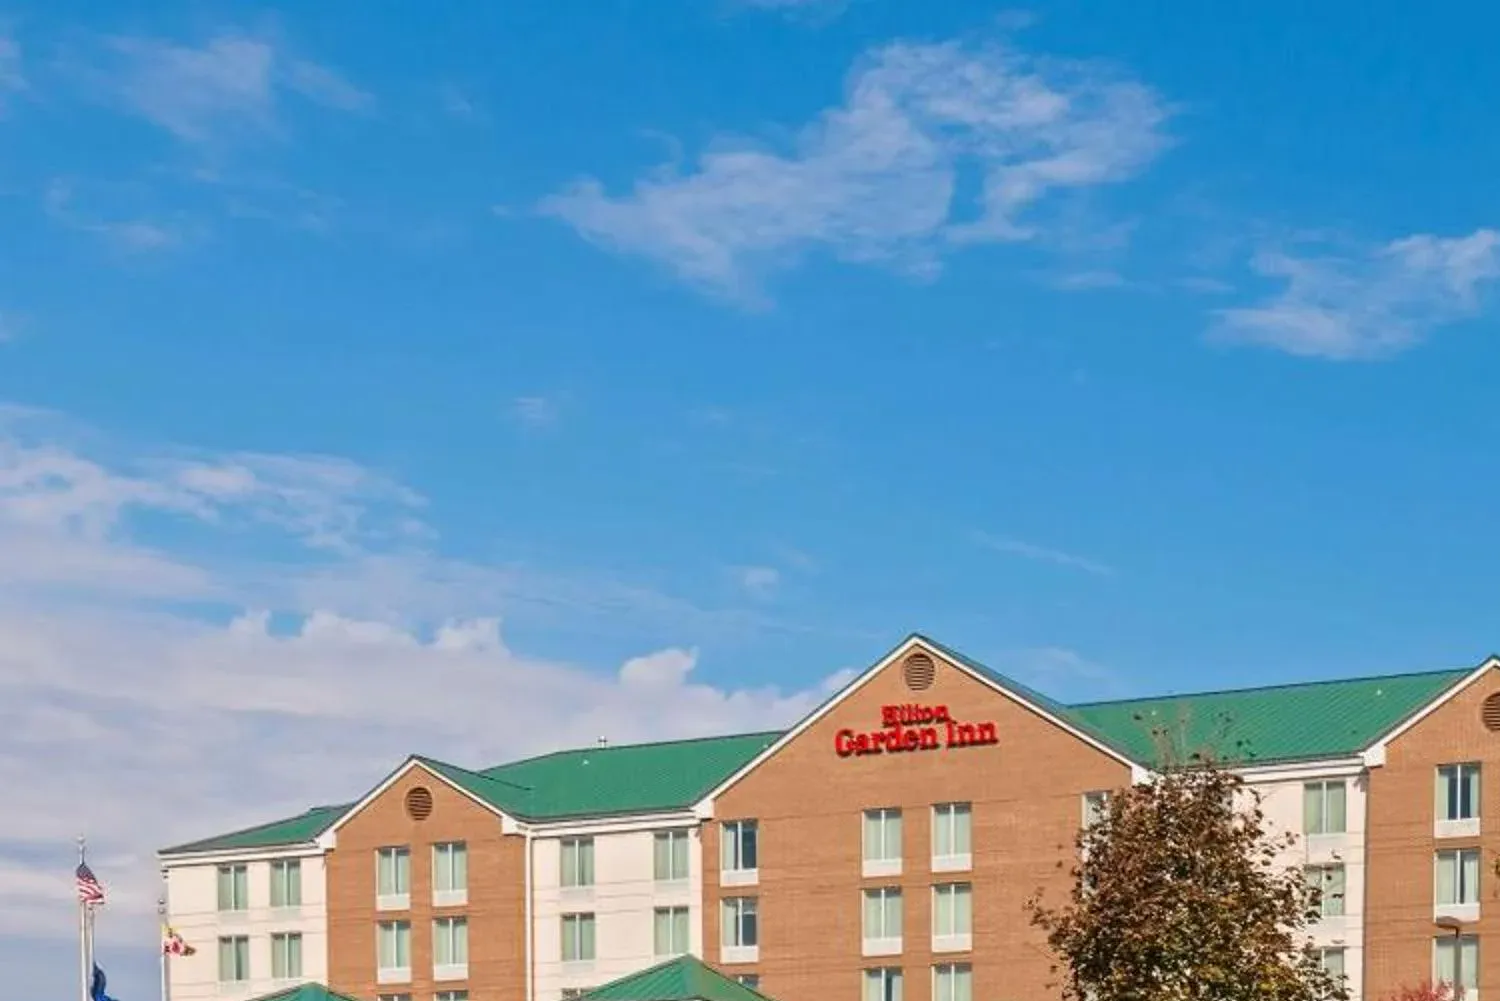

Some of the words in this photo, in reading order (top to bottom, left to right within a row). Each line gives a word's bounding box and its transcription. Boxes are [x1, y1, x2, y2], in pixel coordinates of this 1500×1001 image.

[882, 704, 952, 726] Hilton
[834, 723, 939, 757] Garden
[944, 722, 998, 748] Inn
